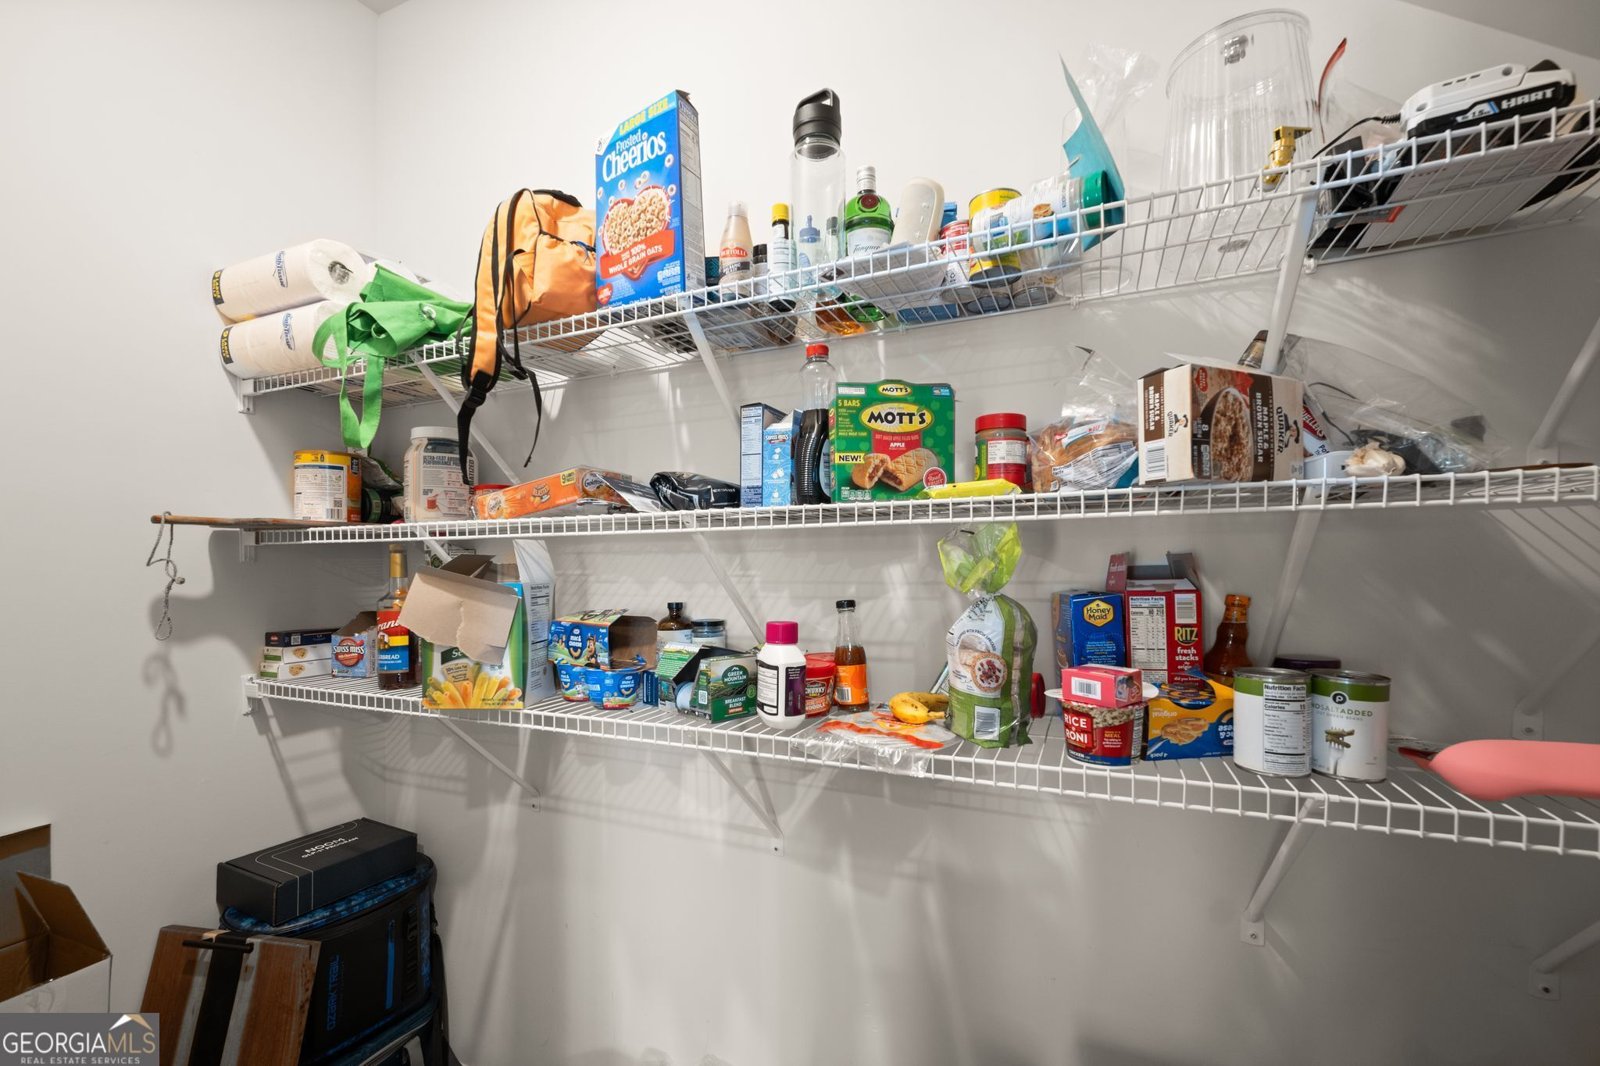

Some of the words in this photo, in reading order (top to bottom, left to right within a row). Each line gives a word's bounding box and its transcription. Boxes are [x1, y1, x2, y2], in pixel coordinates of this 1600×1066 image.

[1501, 87, 1556, 109] HART
[615, 128, 642, 153] Frosted
[602, 131, 667, 183] Cheerios
[853, 243, 881, 254] Tanquer
[608, 260, 628, 275] WHOLE
[628, 251, 646, 265] GRAIN
[646, 244, 663, 256] OATS
[867, 411, 926, 425] MOTT'S
[1256, 392, 1264, 428] BROWN
[1276, 406, 1284, 453] QUAKER
[838, 454, 862, 462] NEW!
[1086, 606, 1112, 615] Honey
[1088, 613, 1108, 621] Maid
[1174, 625, 1199, 643] RITZ
[1177, 646, 1197, 654] fresh
[724, 696, 747, 705] BREAKFAST
[1063, 713, 1088, 728] RICE
[1065, 728, 1089, 743] RONI
[304, 837, 346, 854] NOOM
[326, 991, 337, 1031] OZARK
